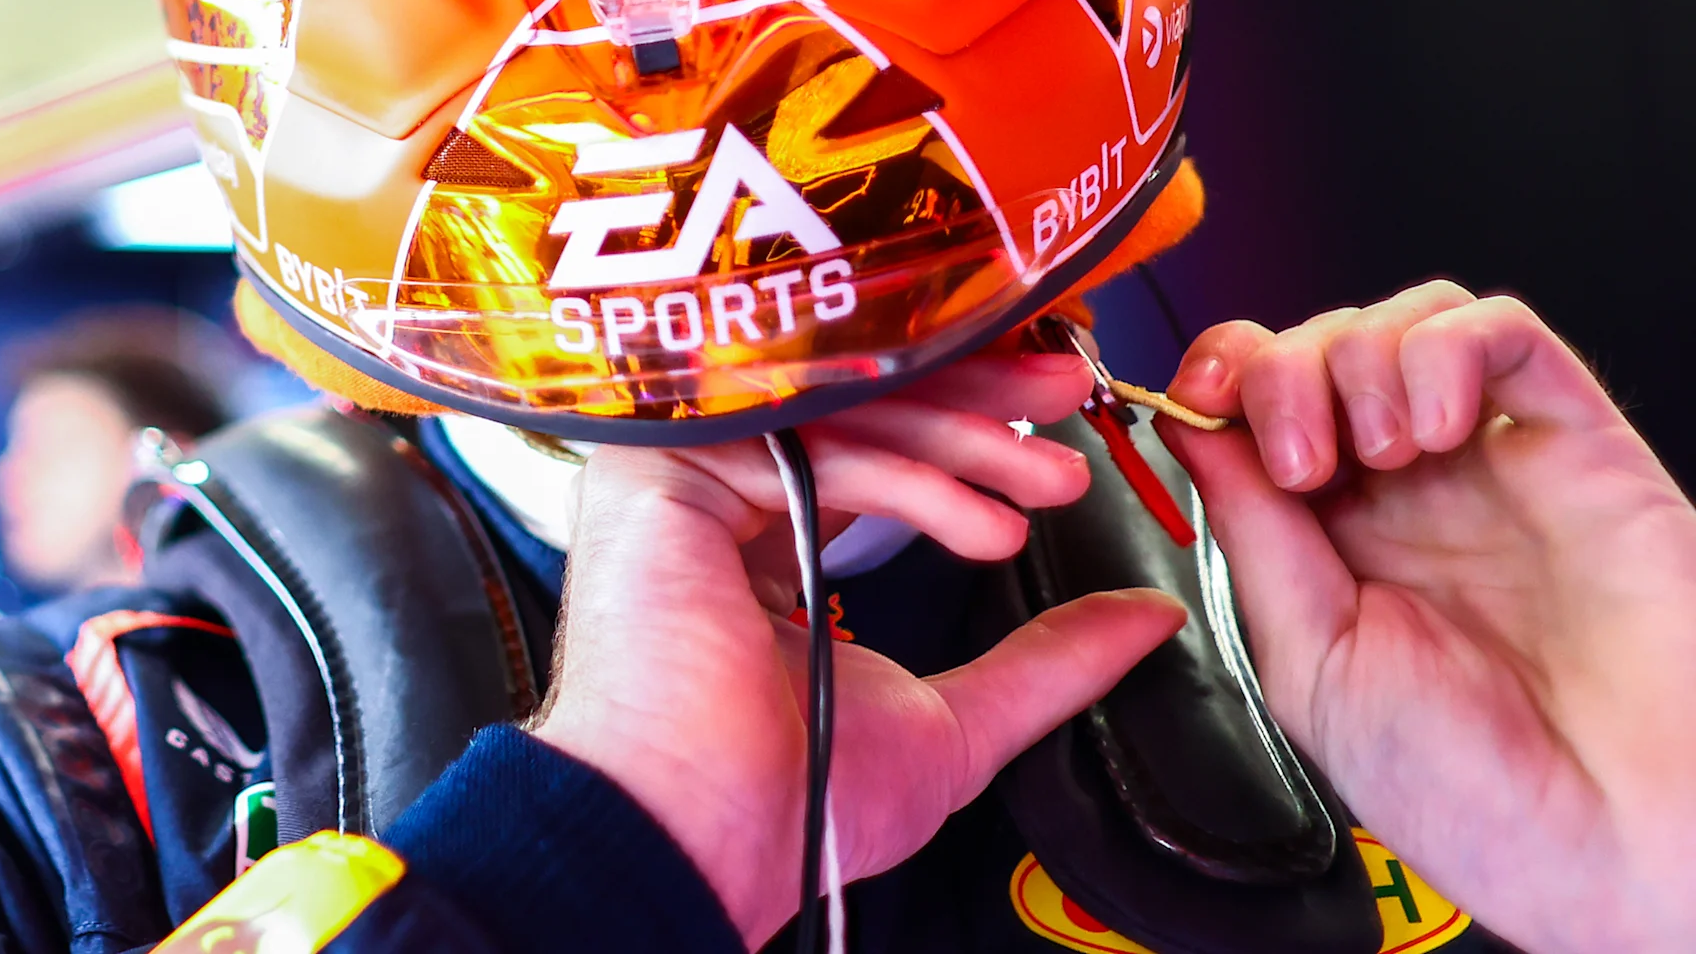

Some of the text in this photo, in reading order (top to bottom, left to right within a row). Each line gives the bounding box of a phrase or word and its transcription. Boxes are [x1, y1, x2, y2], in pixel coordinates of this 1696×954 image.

[547, 122, 843, 290] EA
[1032, 134, 1128, 255] BYBIT
[550, 259, 857, 356] SPORTS
